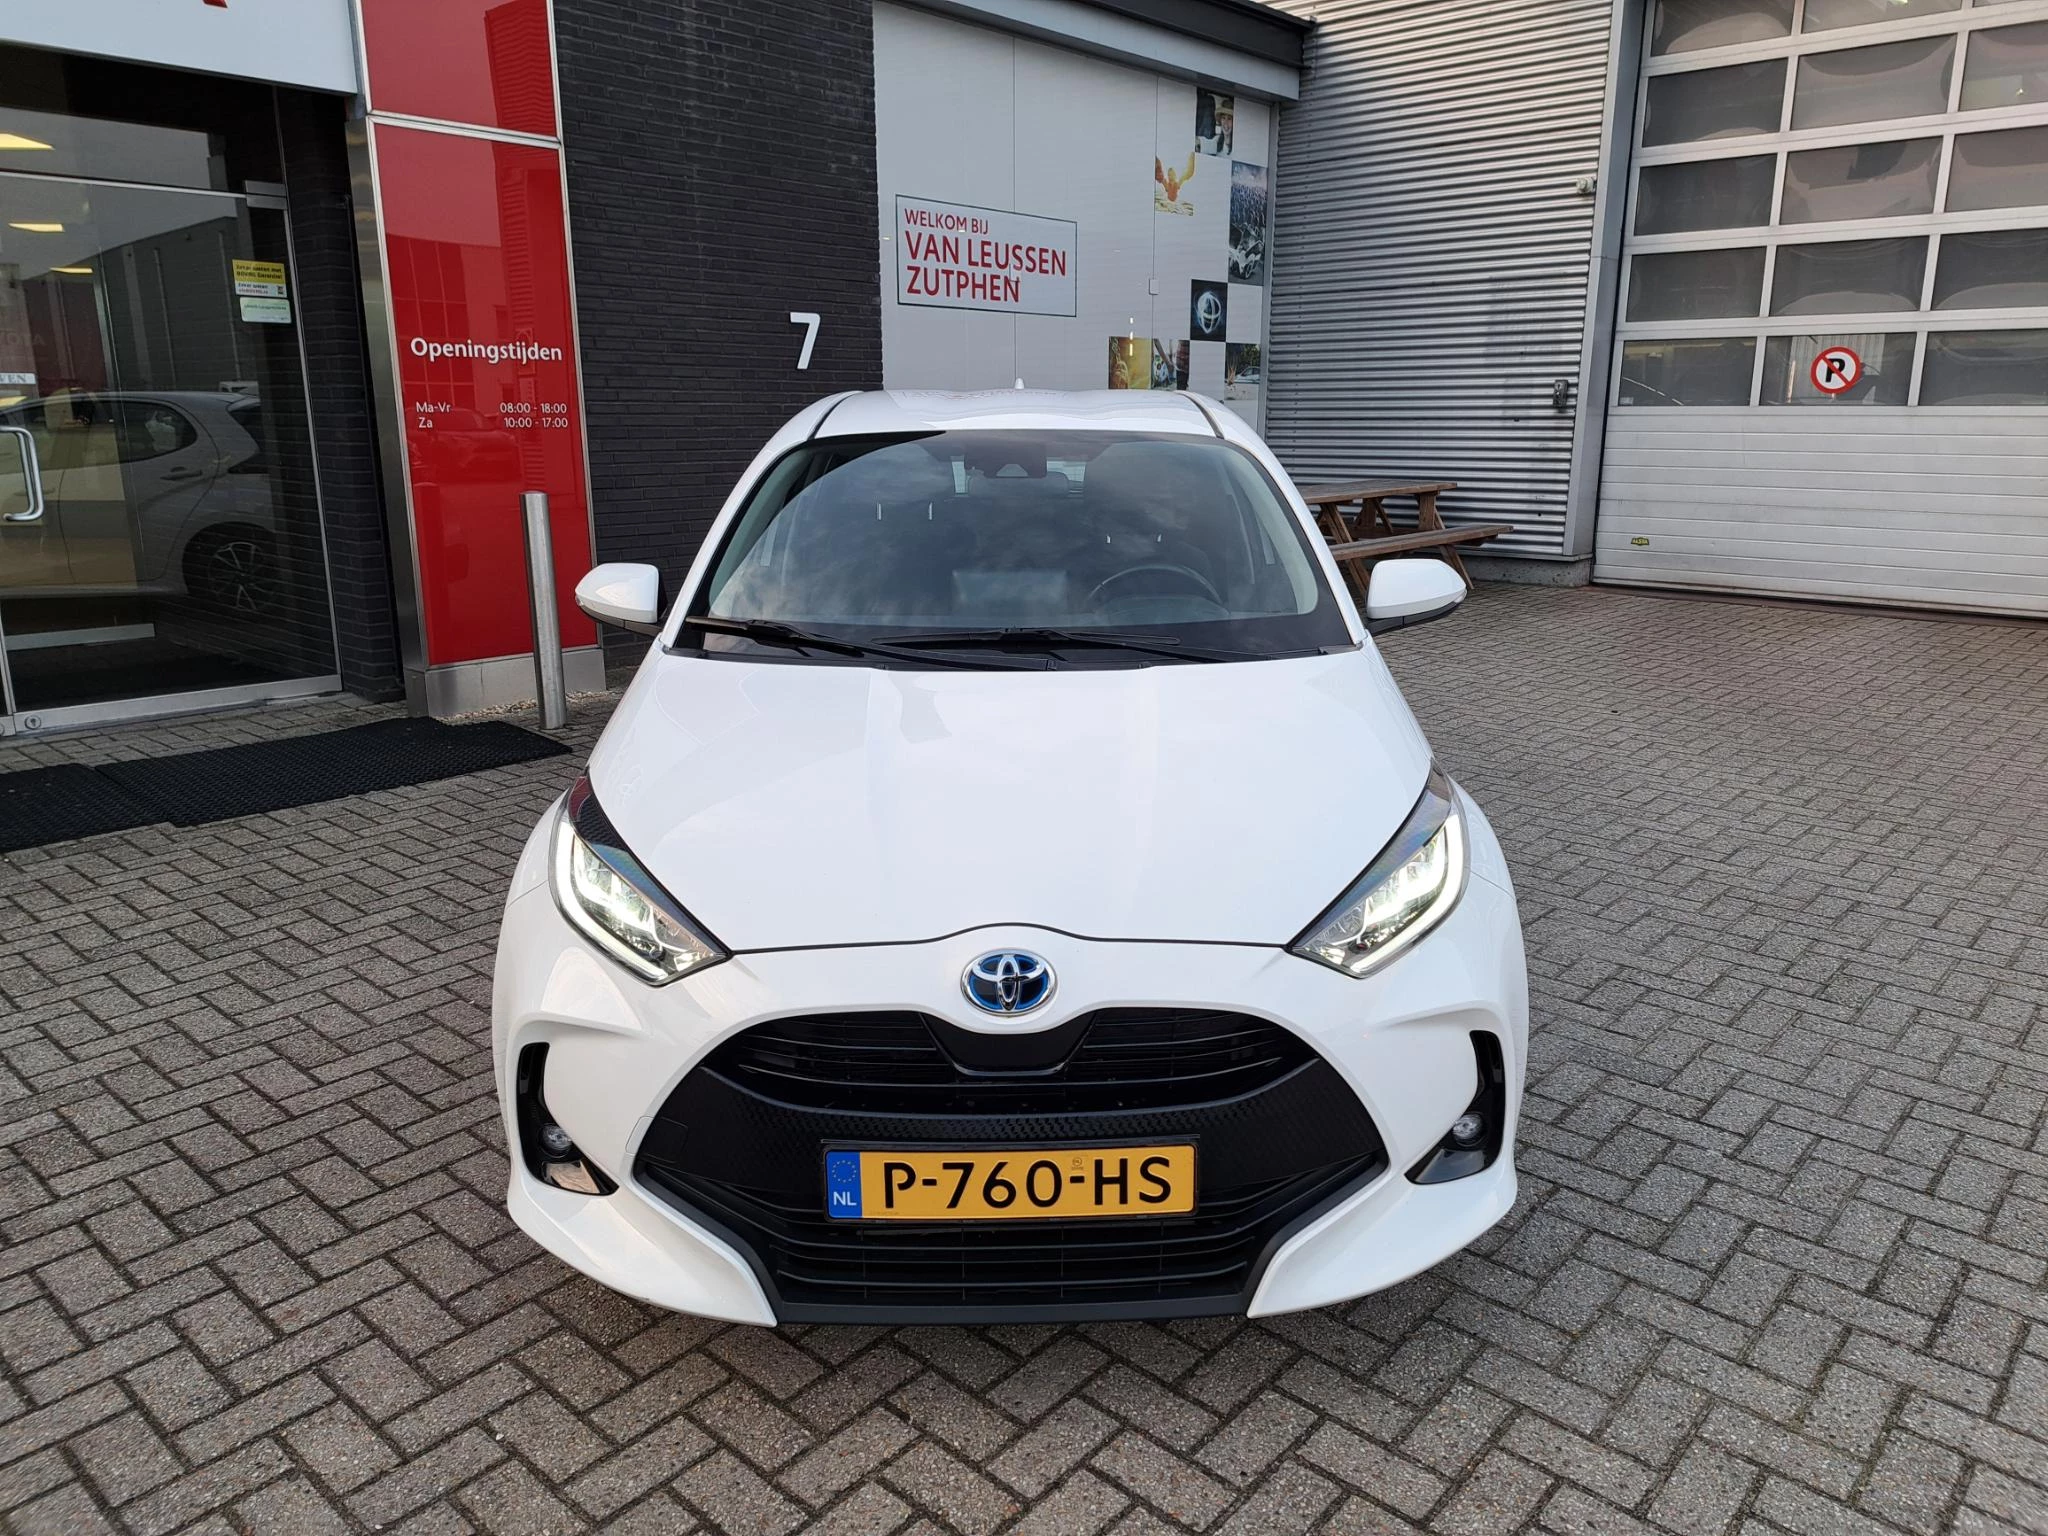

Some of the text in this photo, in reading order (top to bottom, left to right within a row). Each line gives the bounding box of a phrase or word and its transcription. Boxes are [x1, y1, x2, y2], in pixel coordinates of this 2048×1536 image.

[904, 208, 988, 235] WELKOM BIJ
[905, 230, 1066, 277] VAN LEUSSEN
[906, 265, 1020, 303] ZUTPHEN
[410, 337, 563, 365] Openingstijden
[789, 311, 821, 370] 7
[416, 402, 451, 413] Ma-Vr
[500, 402, 531, 413] 08:00
[540, 402, 567, 414] 18:00
[418, 417, 433, 428] Za
[504, 417, 533, 428] 10:00
[542, 417, 568, 428] 17:00
[883, 1156, 1172, 1209] P-760-HS
[833, 1191, 857, 1206] NL
